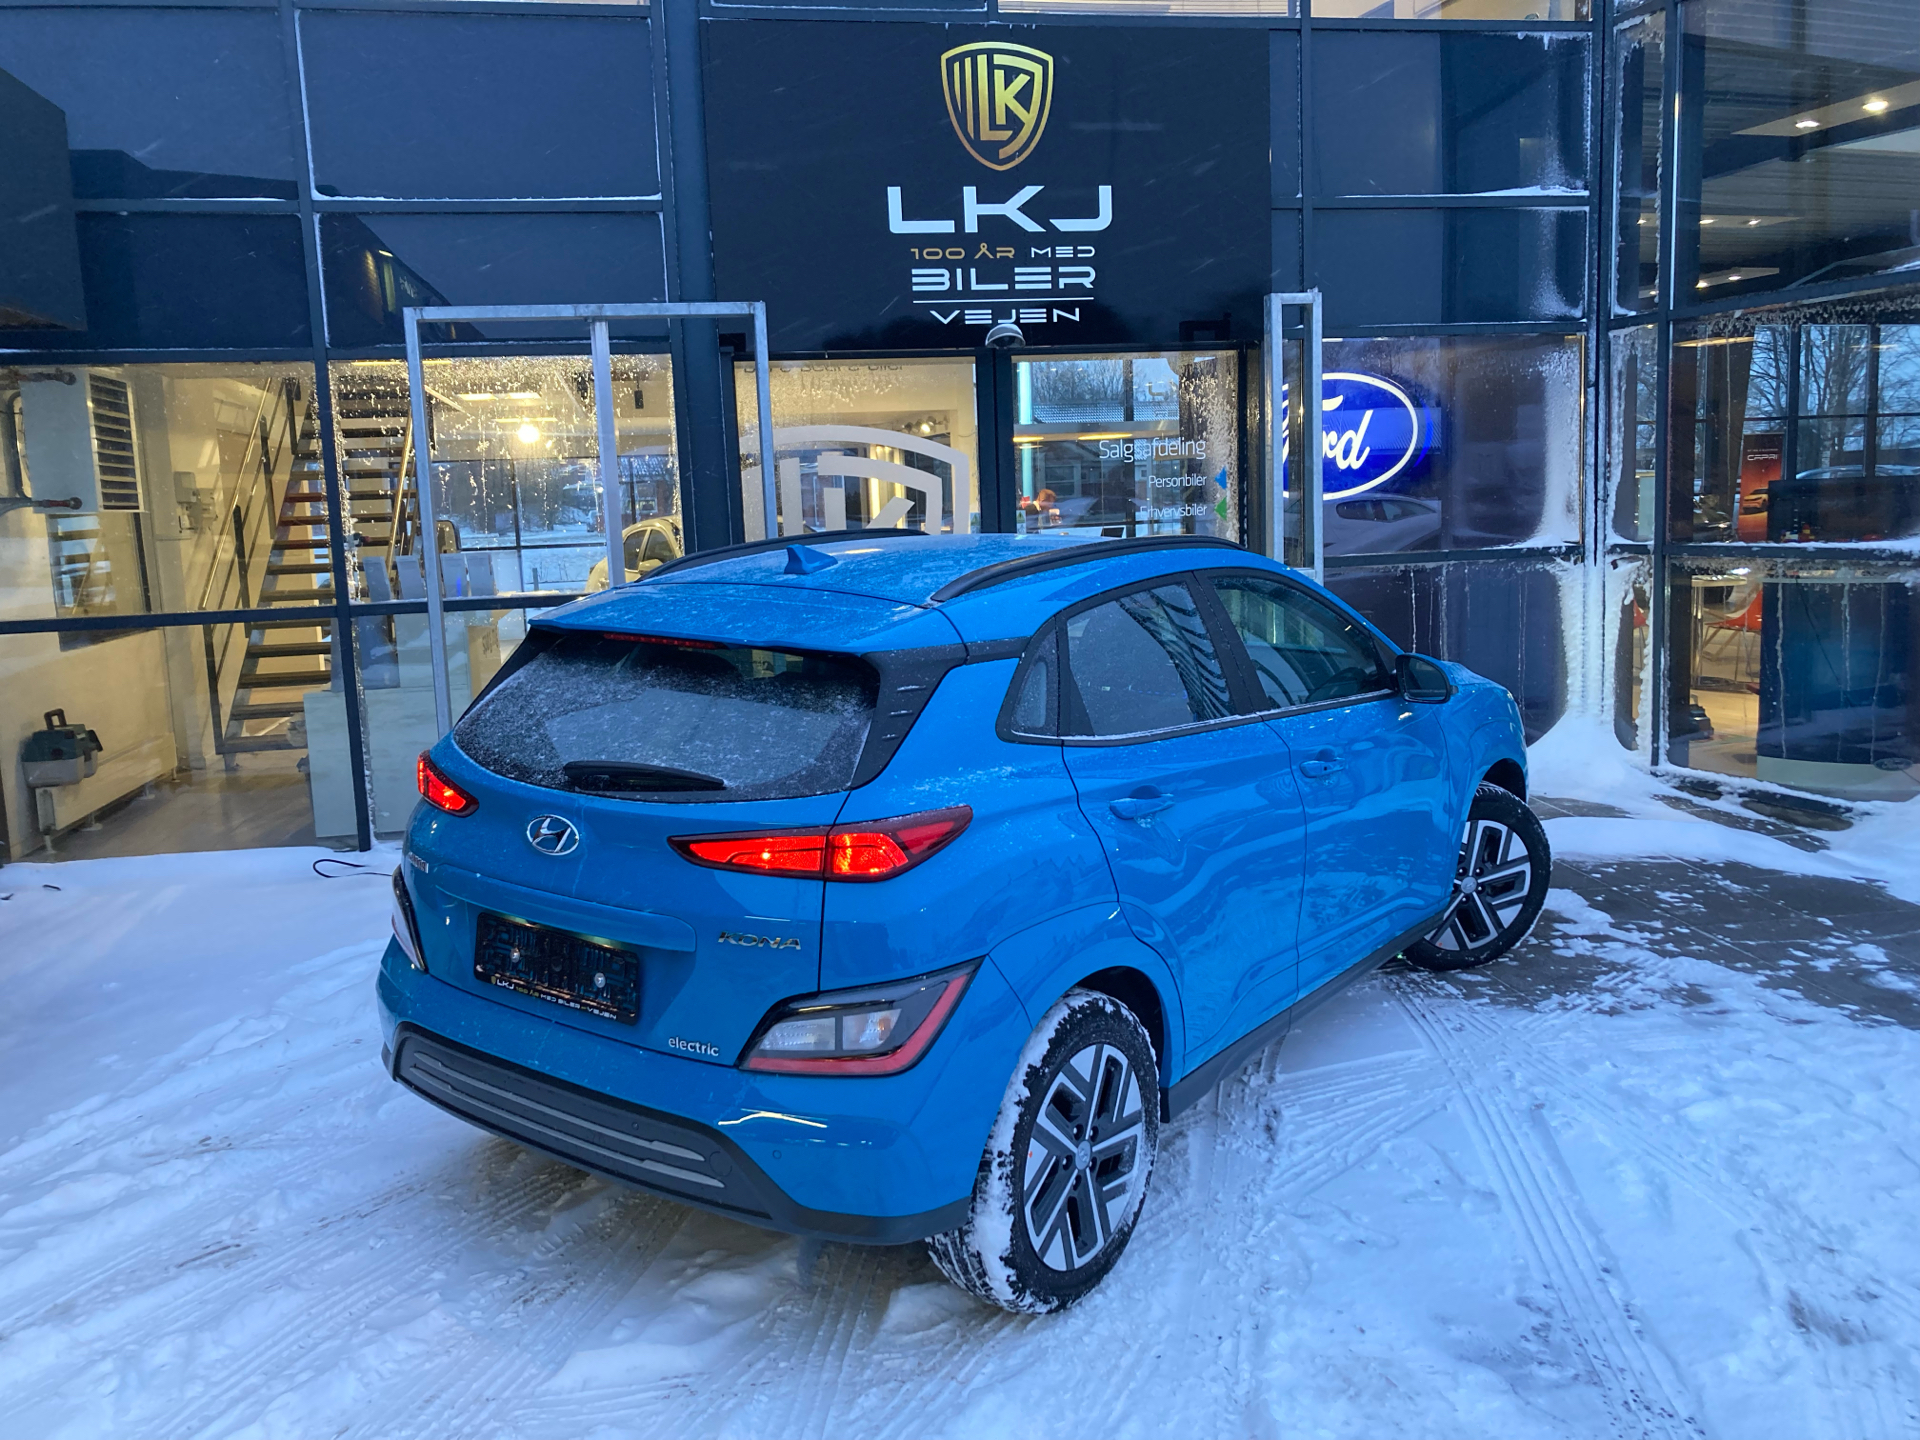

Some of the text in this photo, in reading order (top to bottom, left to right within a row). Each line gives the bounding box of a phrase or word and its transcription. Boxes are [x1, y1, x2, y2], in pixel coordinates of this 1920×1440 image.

[886, 184, 1113, 234] LKJ
[910, 242, 1096, 260] 100 ÅR MED
[911, 266, 1096, 291] BILER
[929, 307, 1080, 325] VEJEN
[1099, 436, 1207, 463] Salgsafdeling
[1148, 474, 1208, 488] Personbiler
[1140, 503, 1208, 518] Erhvervsbiler
[718, 931, 801, 951] KONA
[496, 978, 515, 990] LKJ
[587, 1006, 617, 1020] VEJEN
[668, 1036, 719, 1057] electric
